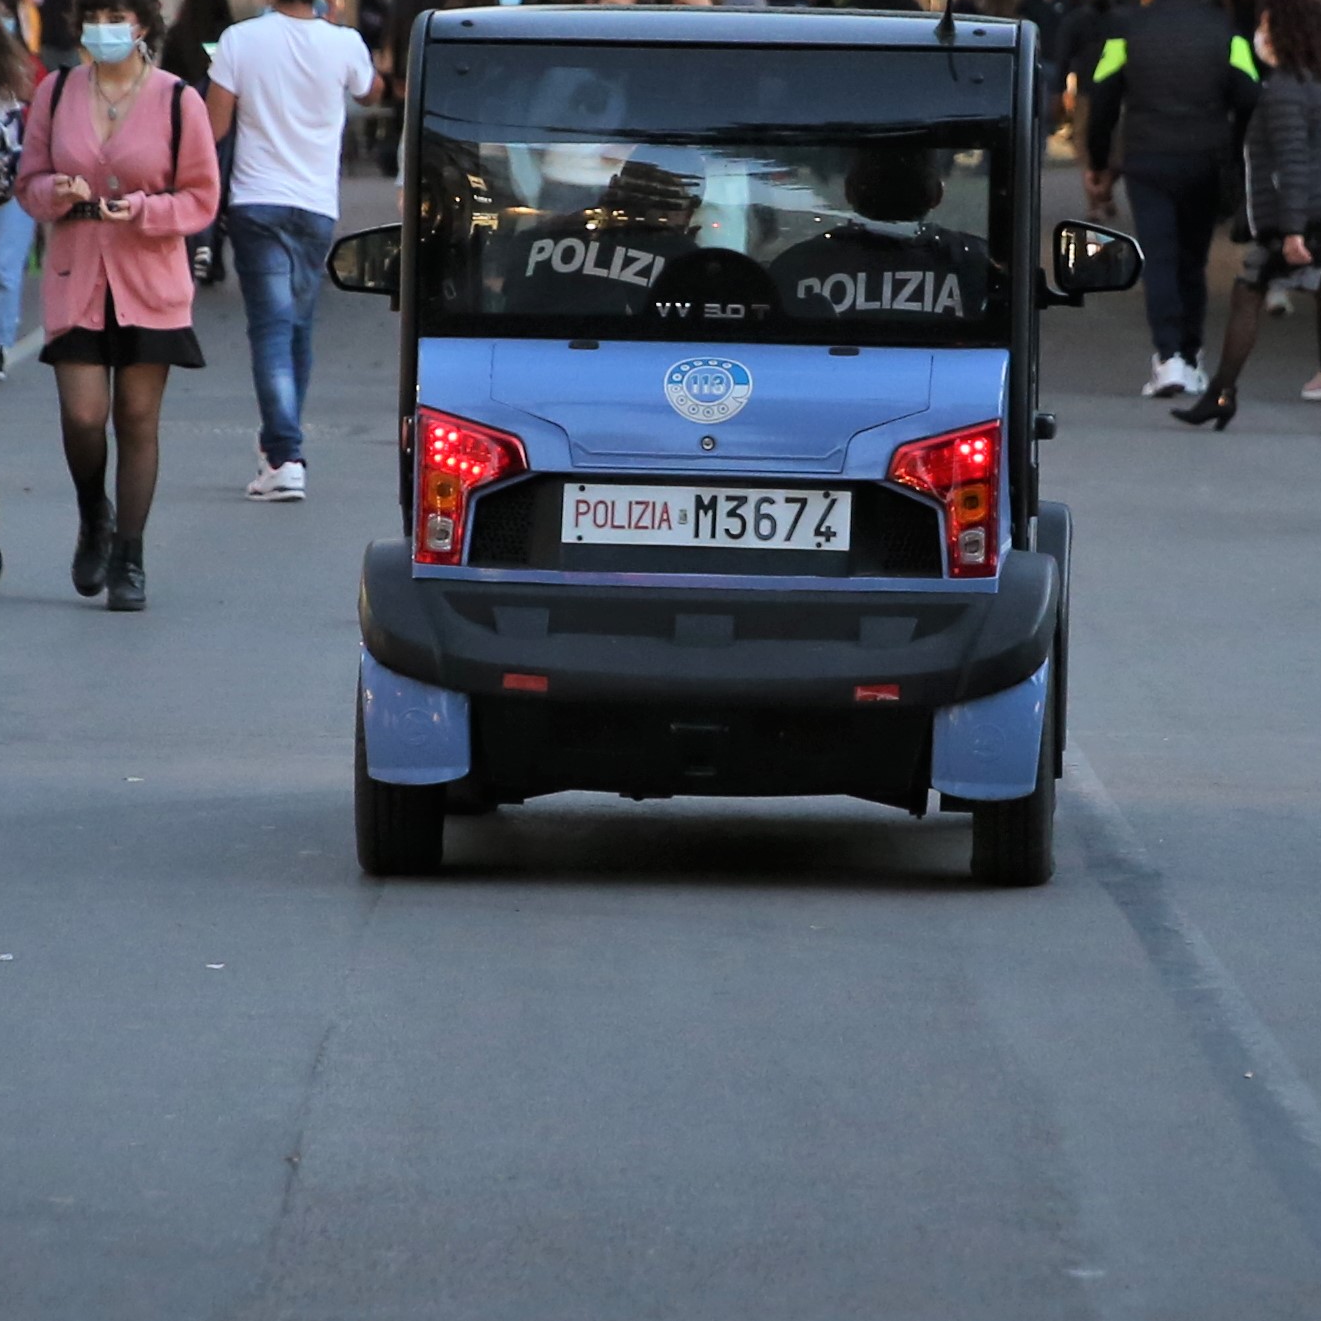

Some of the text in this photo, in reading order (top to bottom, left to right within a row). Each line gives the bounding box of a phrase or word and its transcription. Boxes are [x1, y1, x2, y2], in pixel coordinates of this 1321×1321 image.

[524, 237, 666, 289] POLIZI
[690, 373, 727, 395] 113
[574, 494, 838, 543] POLIZIA M3674
